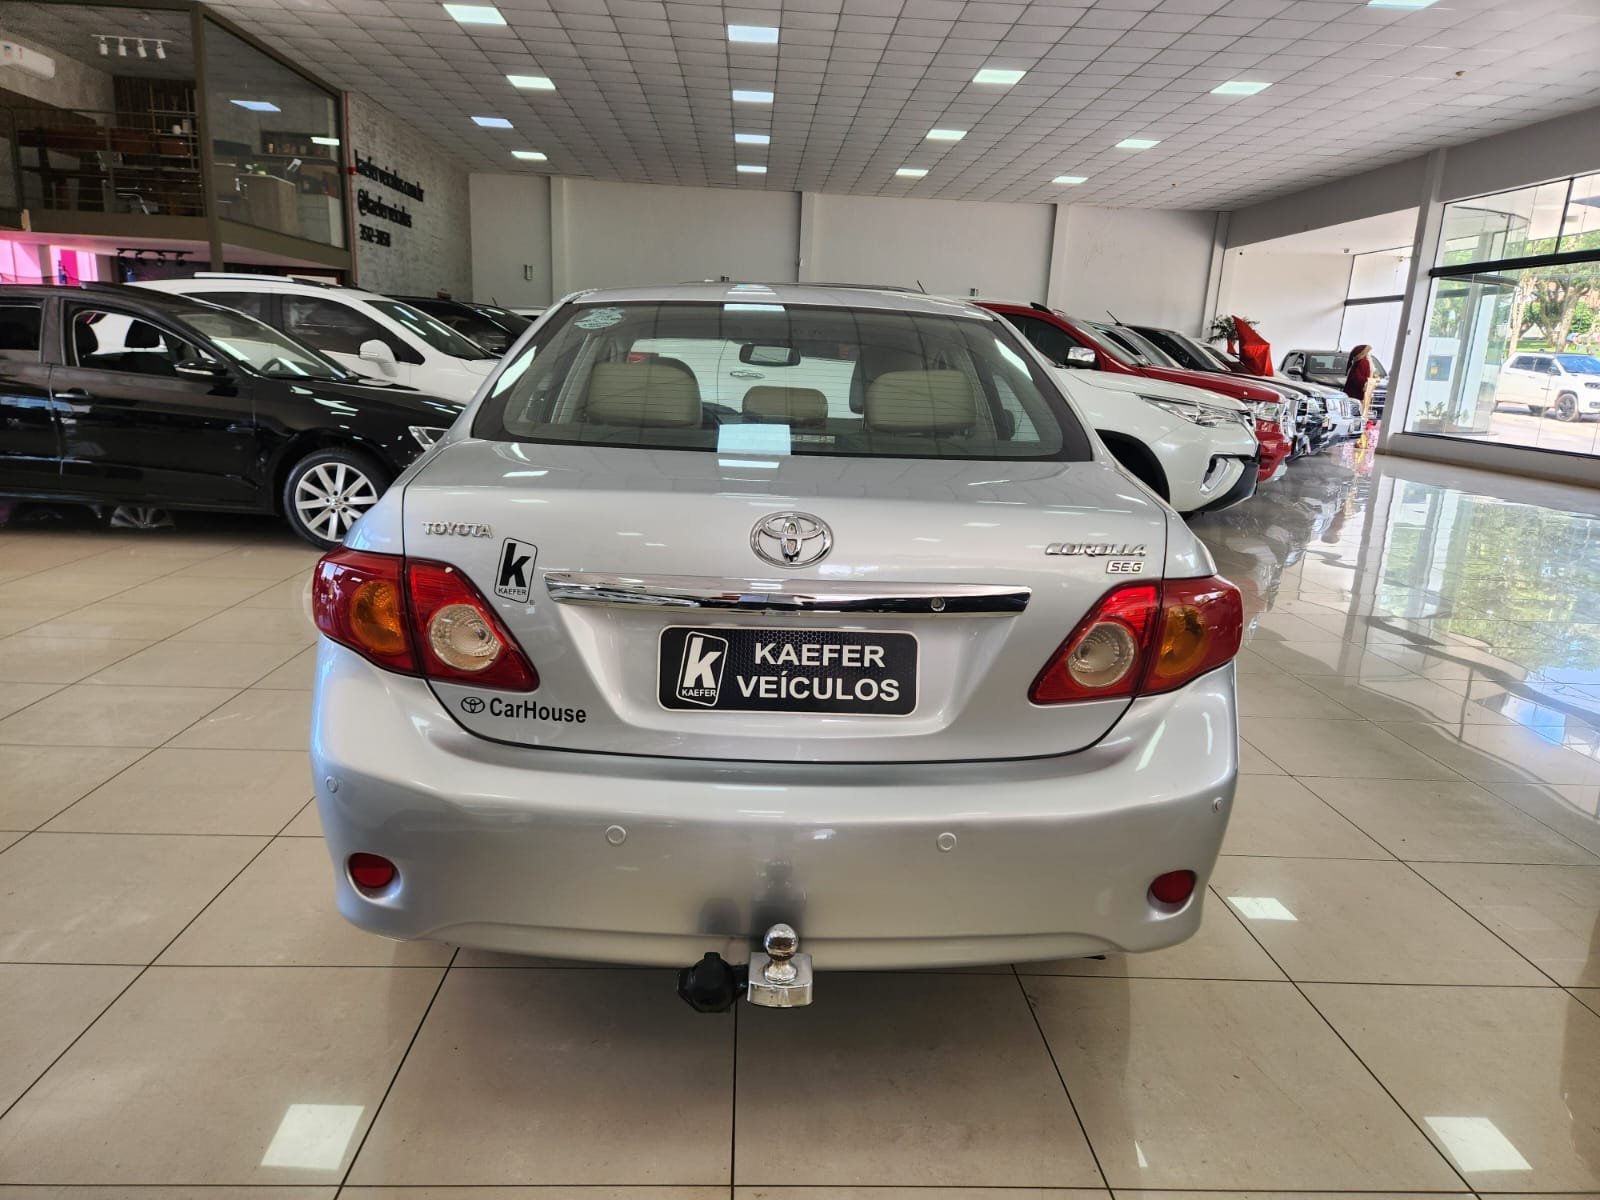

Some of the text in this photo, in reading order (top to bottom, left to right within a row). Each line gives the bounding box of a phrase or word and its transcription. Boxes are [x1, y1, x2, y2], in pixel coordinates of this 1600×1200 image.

[423, 521, 493, 538] TOYOTA
[1045, 543, 1146, 557] COROLLA
[498, 587, 527, 596] KAEFER
[755, 642, 885, 668] KAEFER
[681, 688, 717, 697] KAEFER
[736, 671, 899, 701] VEÍCULOS
[490, 697, 587, 723] CarHouse
